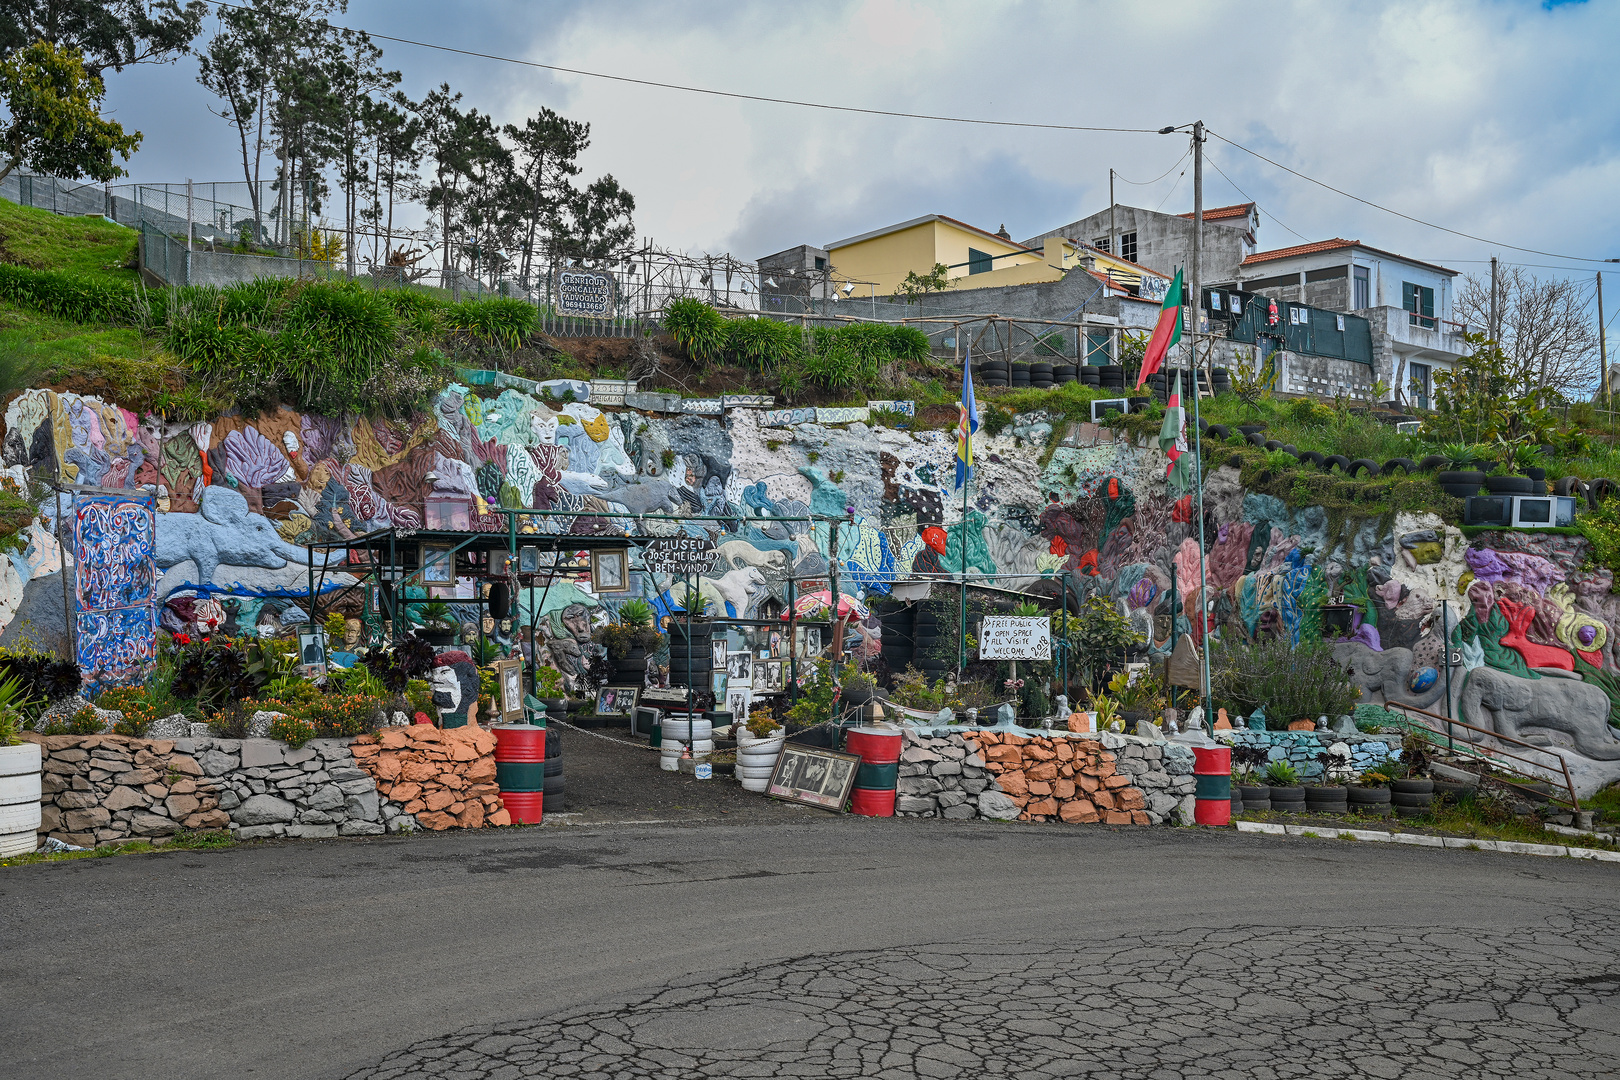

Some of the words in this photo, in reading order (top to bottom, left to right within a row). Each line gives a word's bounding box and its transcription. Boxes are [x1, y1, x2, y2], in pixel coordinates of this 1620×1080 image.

[564, 276, 605, 286] HENRIQUE
[565, 294, 605, 303] ADVOGADO
[660, 539, 705, 550] MUSEU
[992, 620, 1008, 628] FREE
[1013, 629, 1033, 637] SPACE
[991, 638, 1003, 646] ALL
[1030, 635, 1049, 657] 2018
[993, 647, 1025, 656] WELCOME
